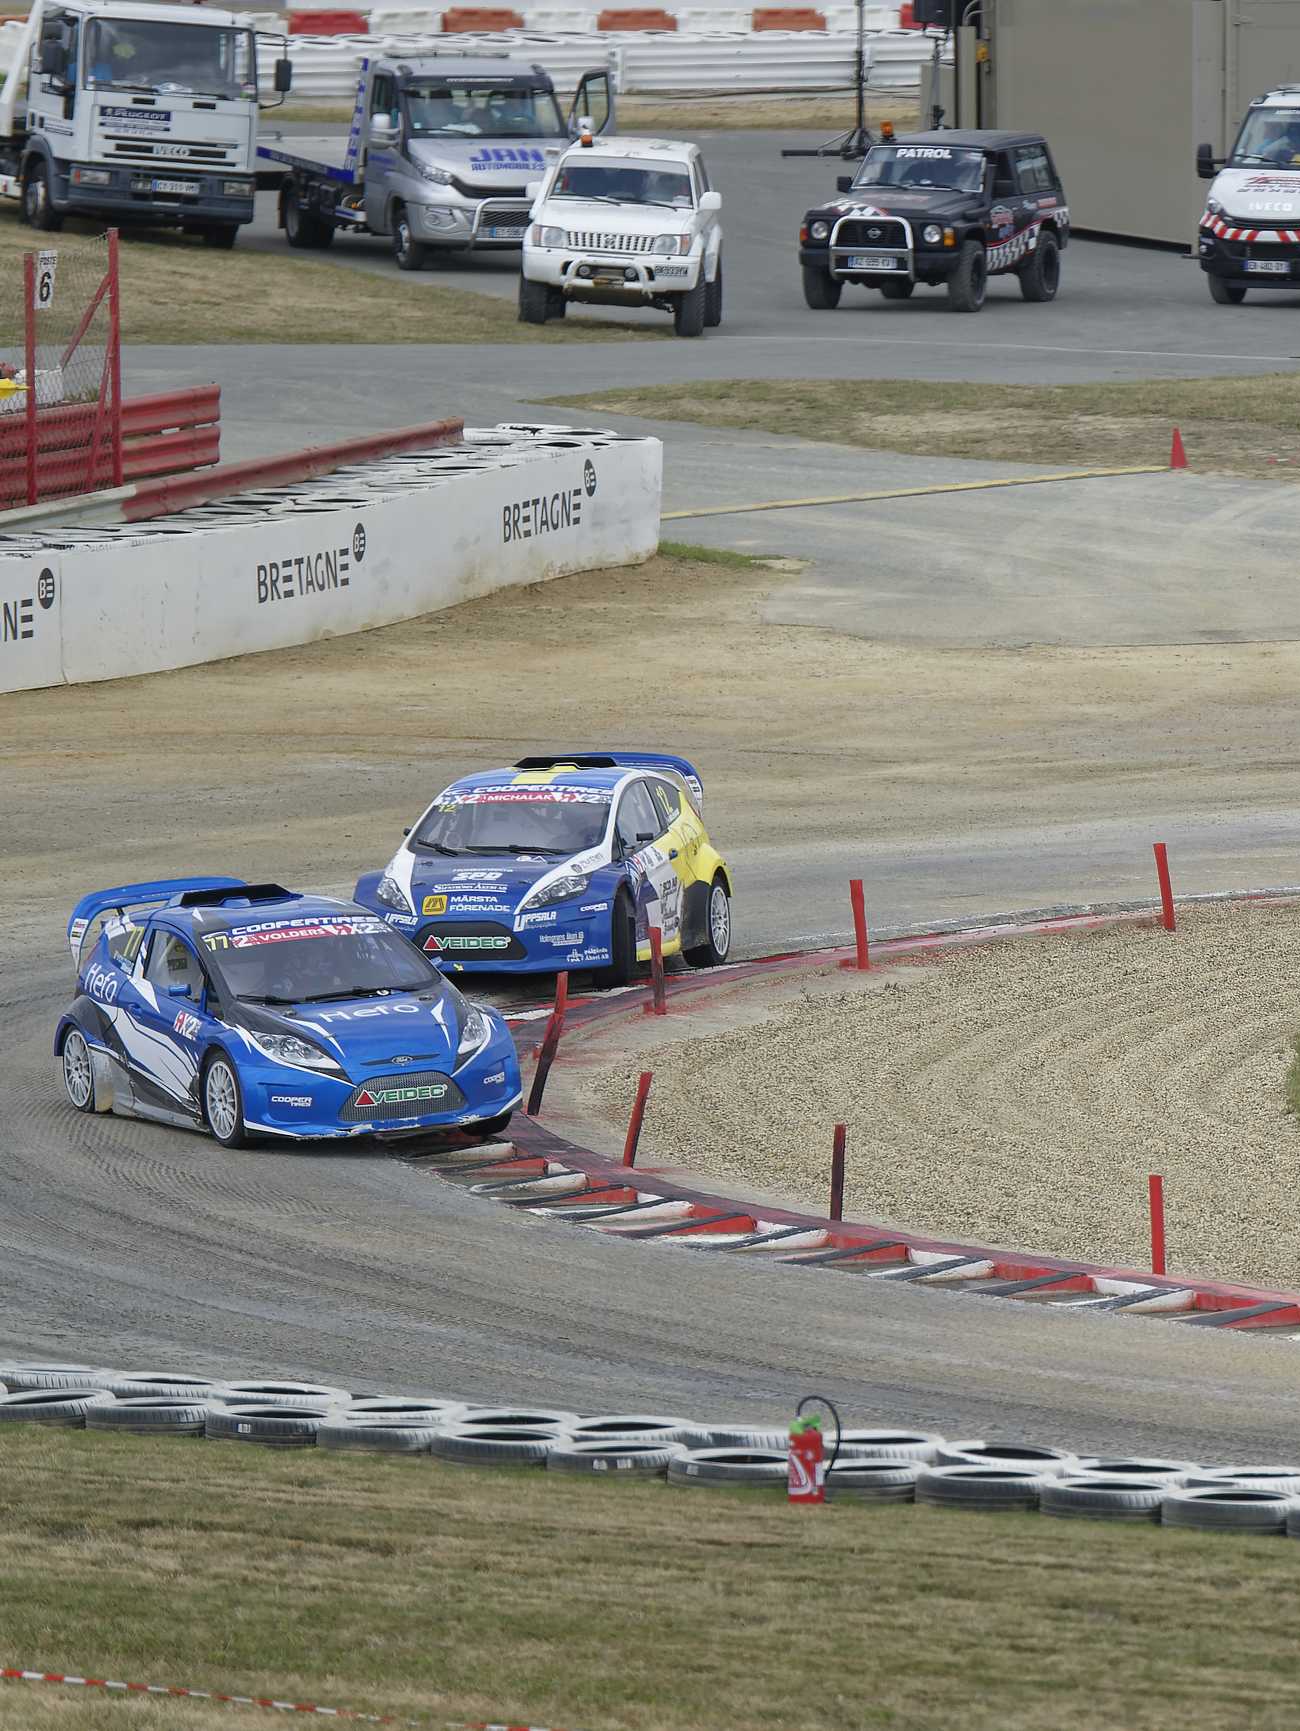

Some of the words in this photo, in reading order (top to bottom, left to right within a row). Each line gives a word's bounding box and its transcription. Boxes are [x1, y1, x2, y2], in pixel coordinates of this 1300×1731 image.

[469, 148, 545, 162] JAN
[896, 149, 952, 159] PATROL
[1248, 201, 1293, 212] IVECO
[40, 271, 51, 302] 6
[503, 487, 582, 543] BRETAGNE
[257, 547, 349, 604] BRETAGNE
[487, 793, 553, 802] MICHALAK
[438, 804, 457, 813] 12
[449, 904, 511, 912] FÖRENADE
[513, 911, 557, 932] UPPSALA
[124, 926, 145, 957] 77
[258, 928, 325, 942] VOLDERS
[439, 936, 511, 949] VEIDEC
[204, 935, 229, 952] 77
[84, 962, 118, 1003] Hefo
[318, 1004, 419, 1023] Hefo
[271, 1095, 312, 1103] COOPER
[371, 1084, 448, 1104] VEIDEC
